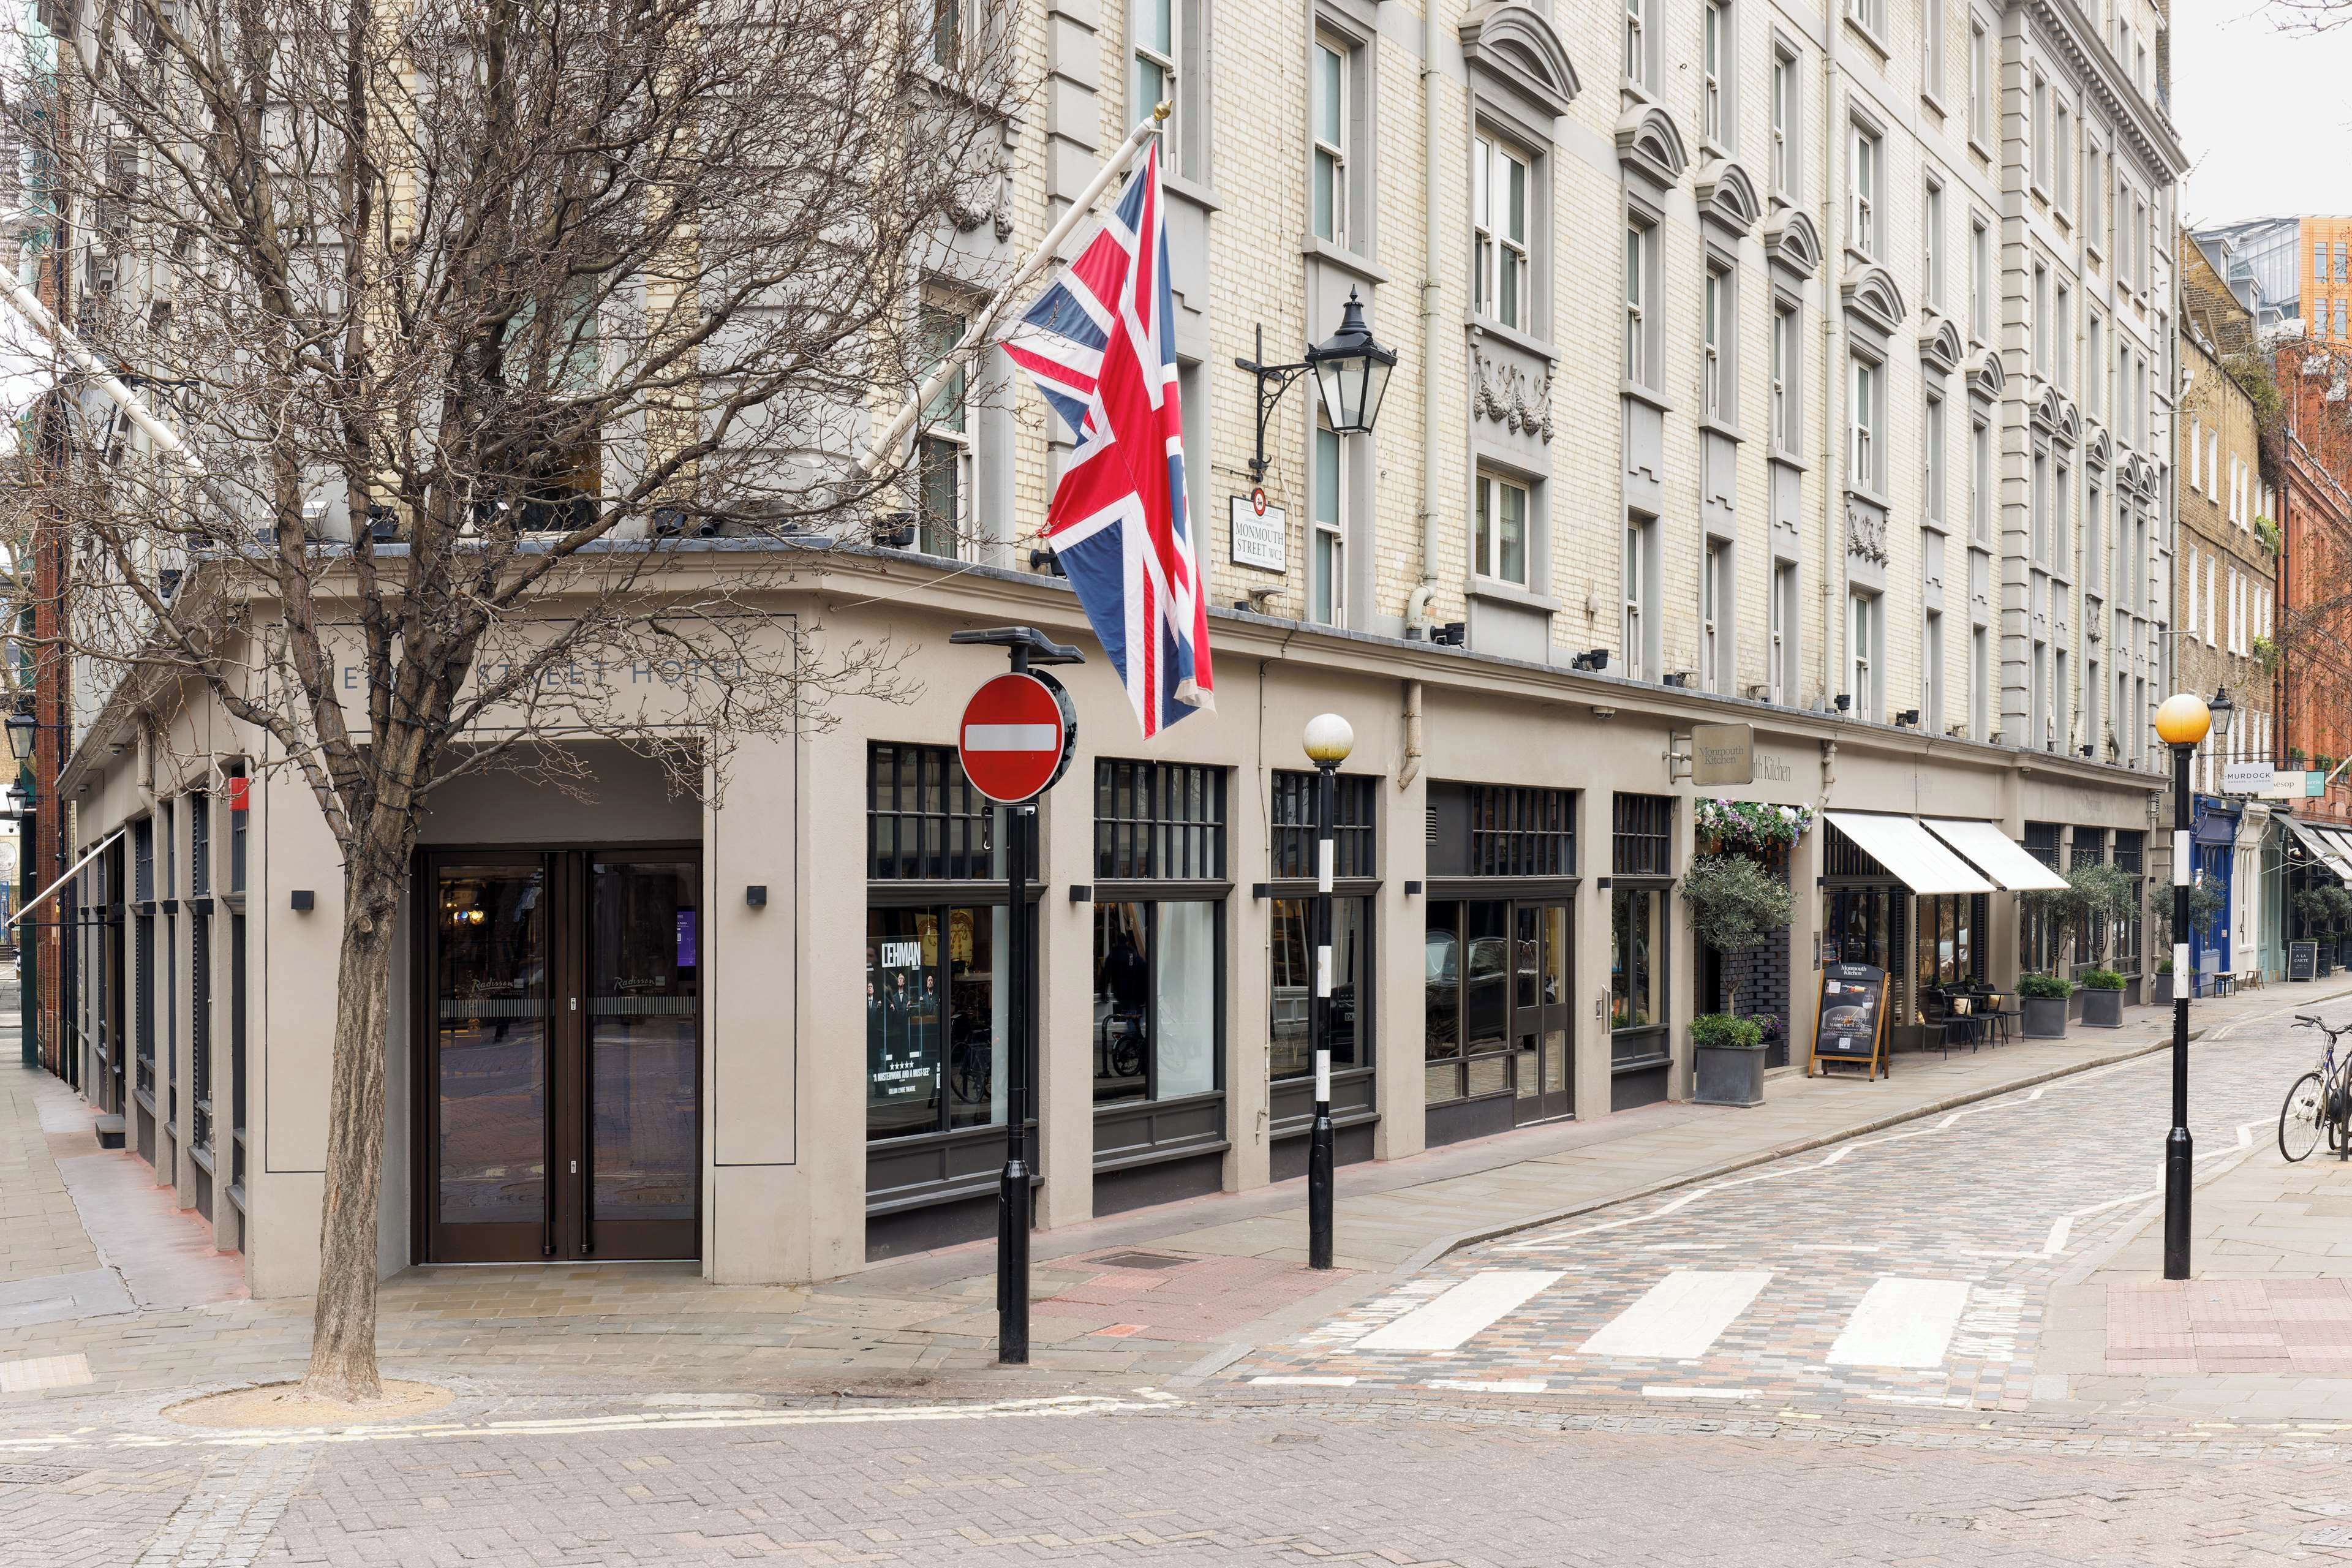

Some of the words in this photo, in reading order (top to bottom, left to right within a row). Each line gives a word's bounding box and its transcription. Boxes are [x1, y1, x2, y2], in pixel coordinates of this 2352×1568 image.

[1235, 521, 1284, 545] MONMOUTH
[1237, 538, 1267, 557] STREET
[1268, 548, 1283, 560] WC2
[1698, 745, 1744, 756] Monmouth
[1705, 755, 1736, 765] Kitchen
[1764, 755, 1791, 782] Kitchen
[882, 941, 921, 968] LEHMAN
[472, 977, 513, 992] Radisson
[614, 975, 655, 990] Radisson
[877, 1071, 902, 1082] MASTERWORK
[910, 1069, 913, 1078] A
